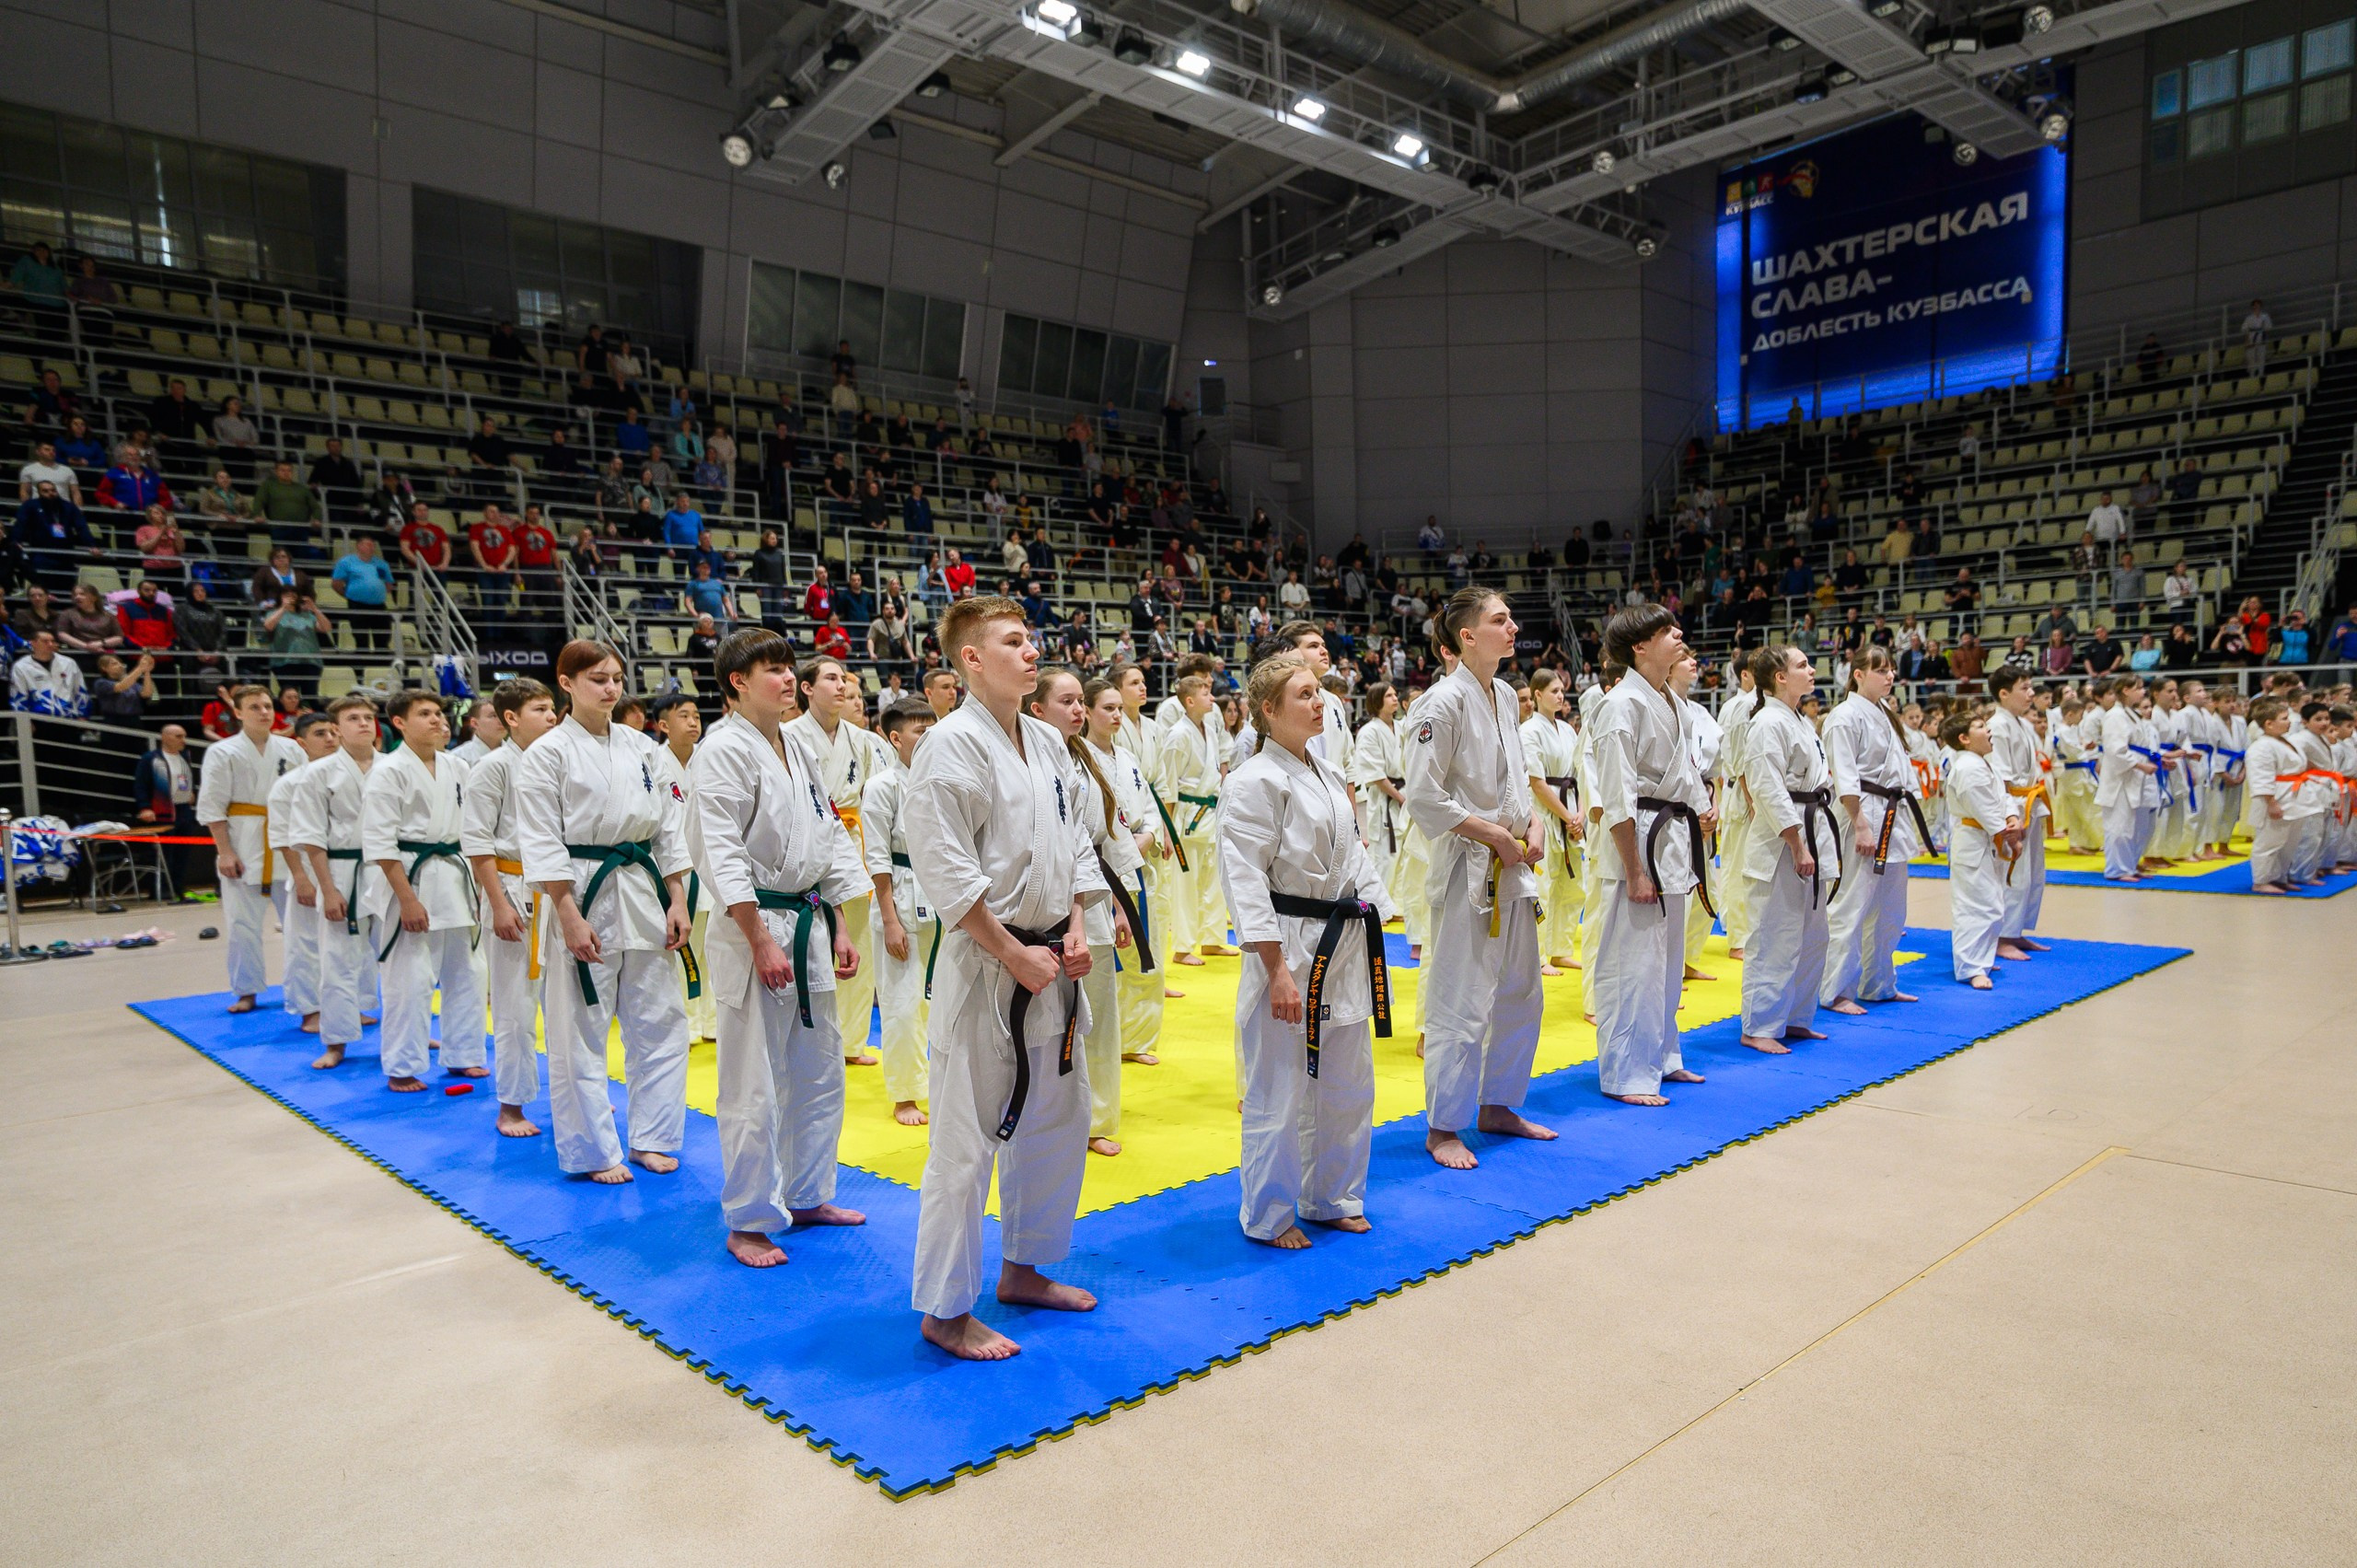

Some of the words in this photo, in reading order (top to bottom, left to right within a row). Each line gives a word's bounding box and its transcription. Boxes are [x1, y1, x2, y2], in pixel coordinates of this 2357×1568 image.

[1752, 191, 2028, 286] ШАХТЕРСКАЯ
[1752, 310, 1882, 352] ДОБЛЕСТЬ
[1887, 276, 2030, 323] КУЗБАССА
[478, 650, 549, 664] ЫХОД
